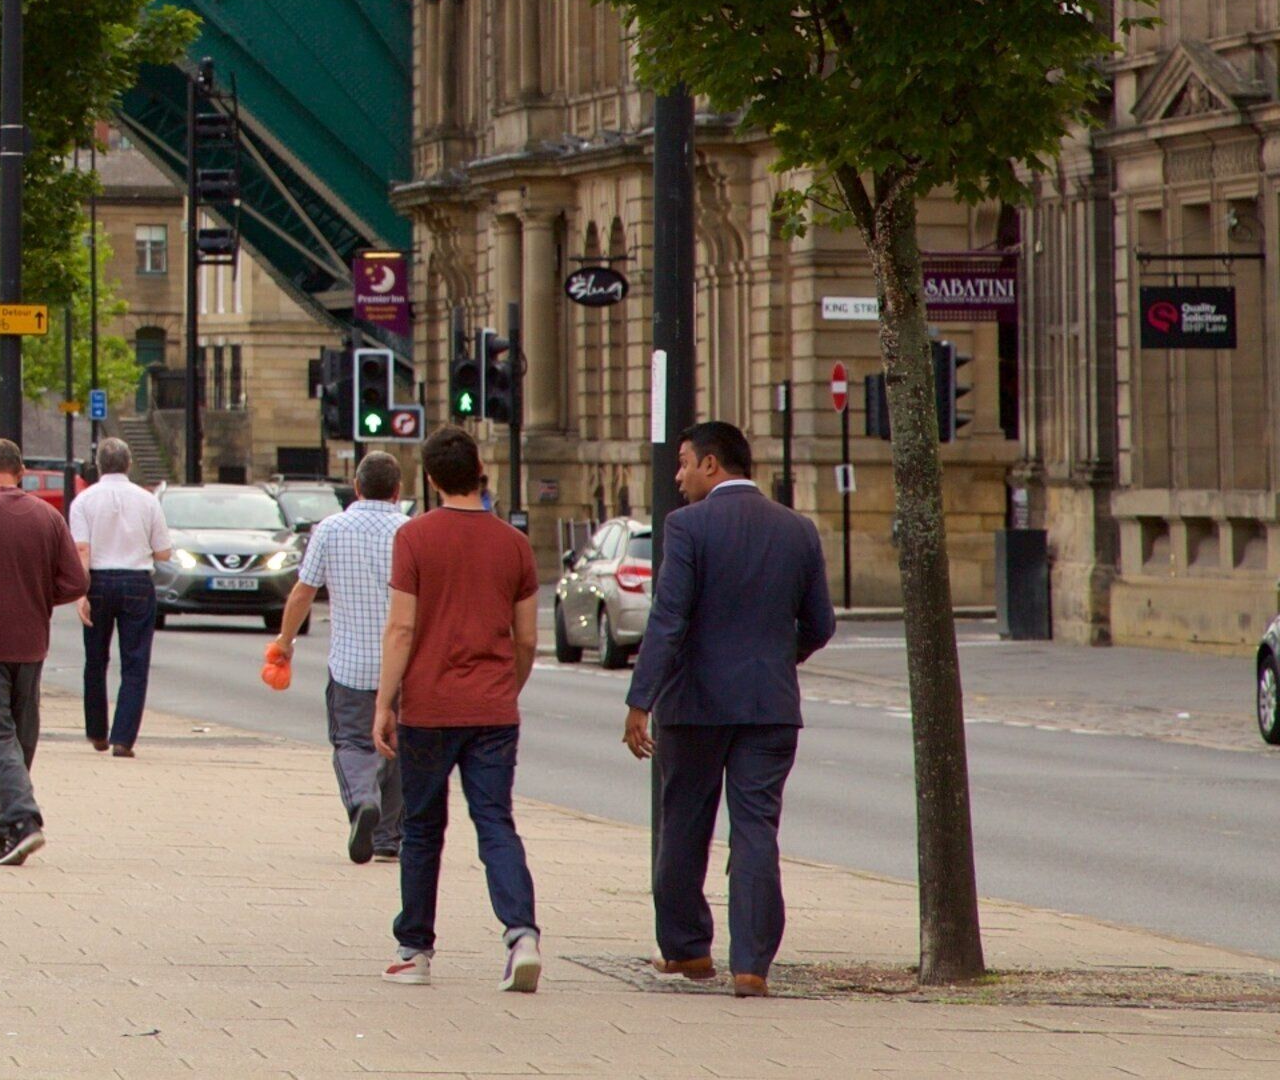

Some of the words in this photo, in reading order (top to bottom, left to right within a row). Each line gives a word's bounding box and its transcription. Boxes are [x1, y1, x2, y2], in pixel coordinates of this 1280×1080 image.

[924, 278, 1014, 297] SABATINI
[2, 307, 32, 316] Detour
[824, 303, 848, 314] KING
[1181, 302, 1217, 313] Quality
[1181, 313, 1228, 322] Solicitors
[1206, 322, 1227, 332] Law
